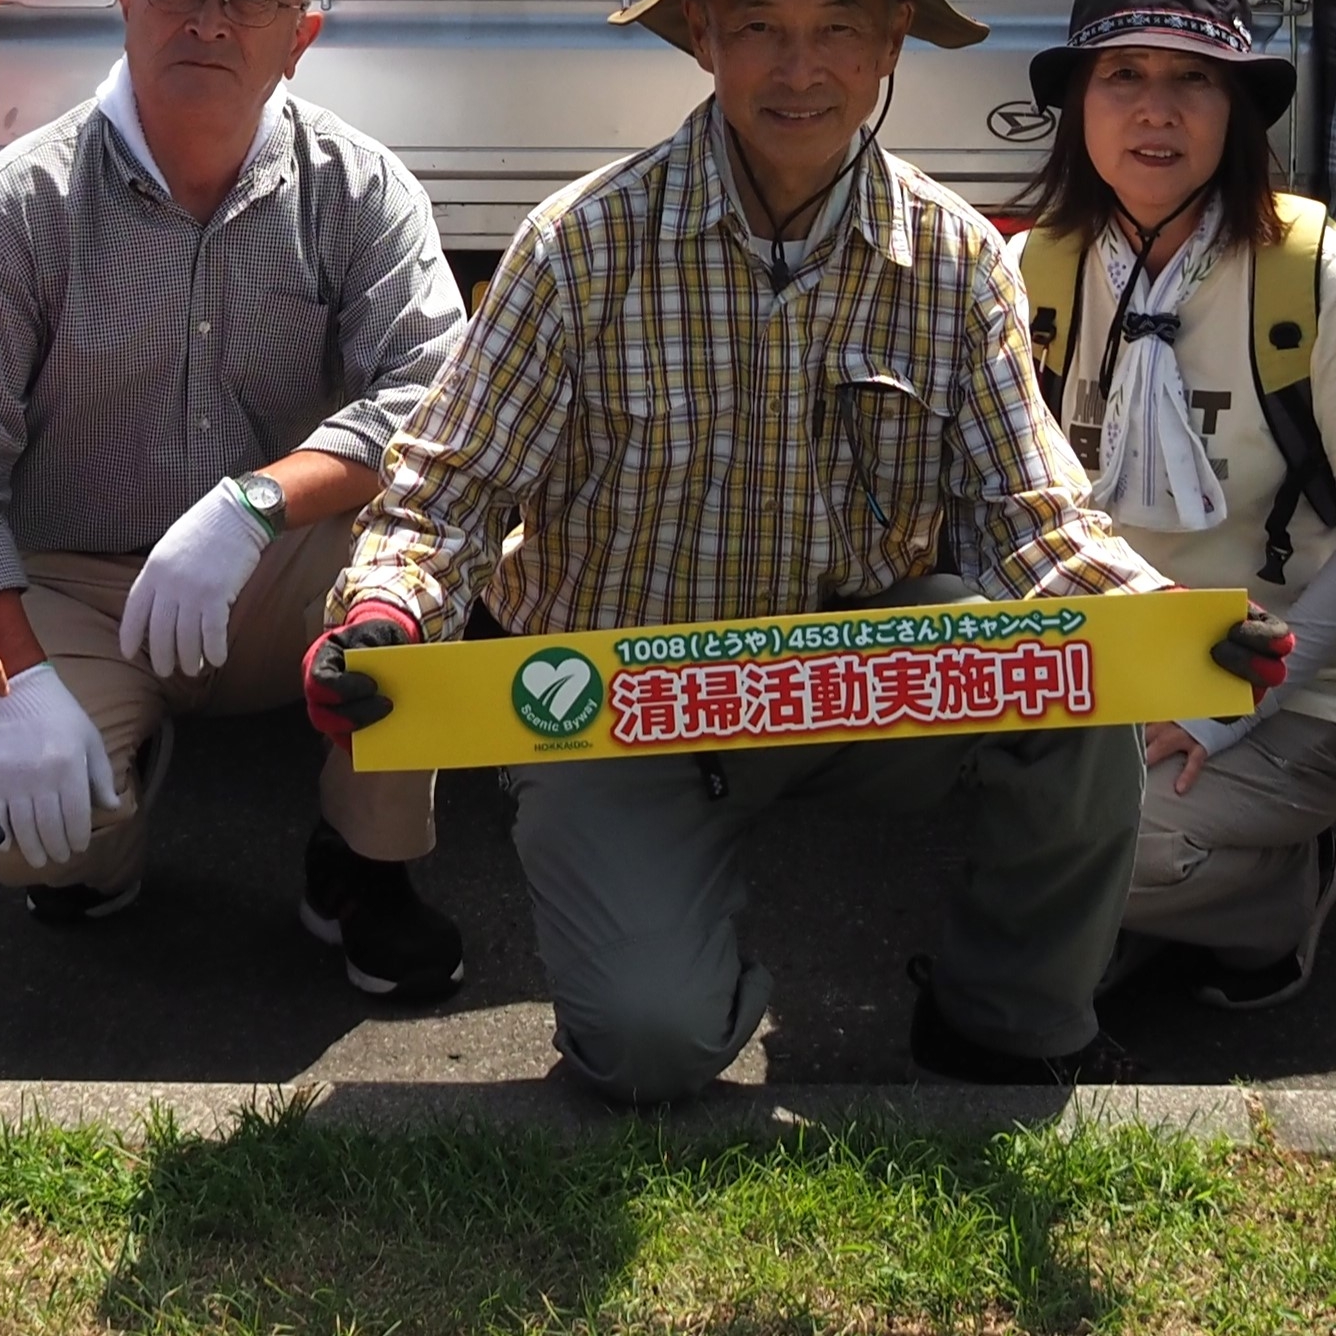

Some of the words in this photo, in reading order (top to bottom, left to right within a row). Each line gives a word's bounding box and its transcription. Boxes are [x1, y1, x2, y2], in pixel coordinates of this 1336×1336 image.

[520, 703, 560, 733] Scenic
[562, 697, 599, 732] Byway
[613, 642, 1092, 743] 清掃活動実施中!
